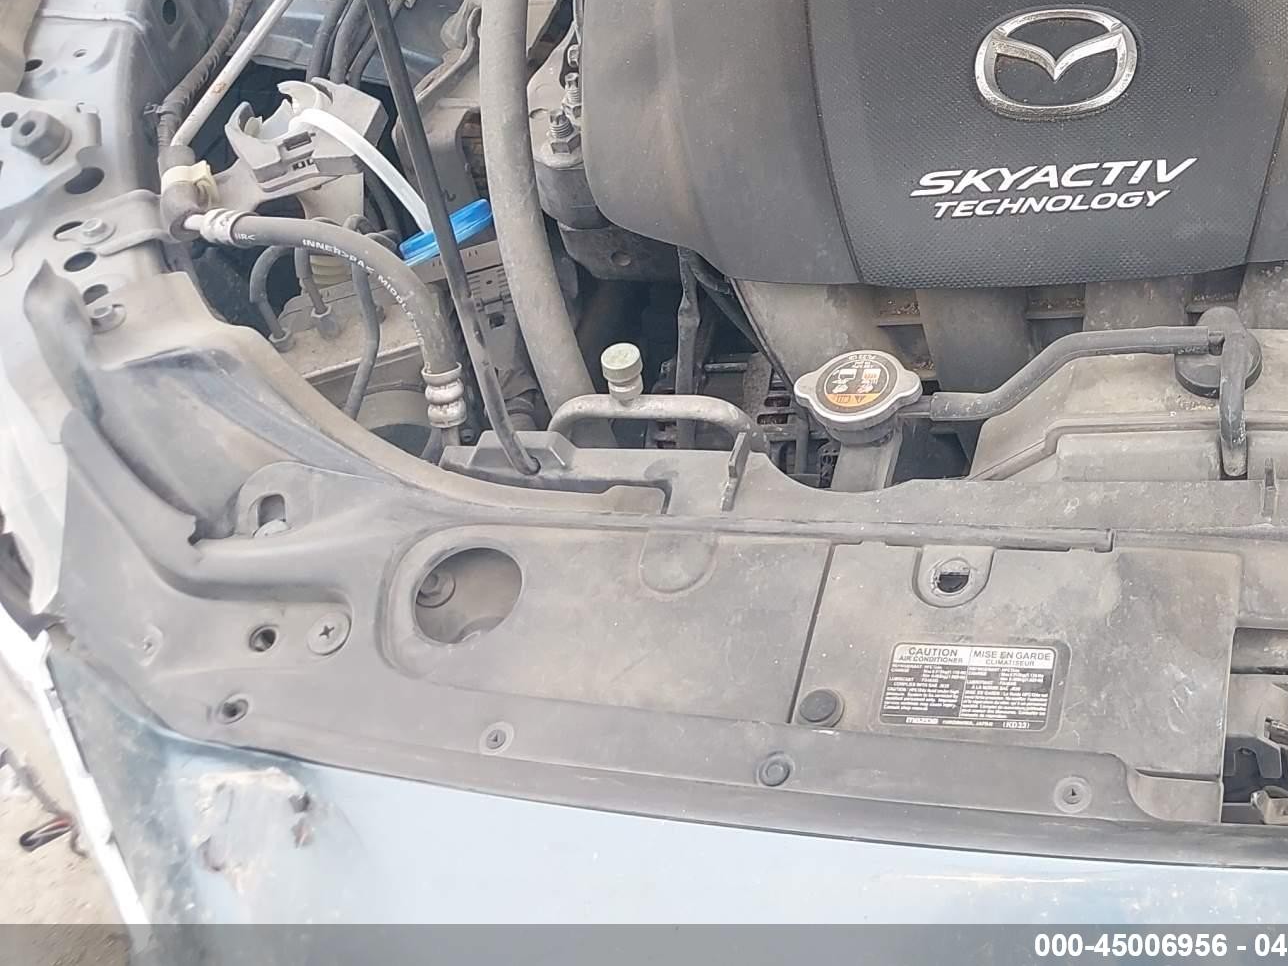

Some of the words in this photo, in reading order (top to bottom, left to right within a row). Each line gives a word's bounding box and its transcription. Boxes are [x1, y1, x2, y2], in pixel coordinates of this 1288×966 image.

[910, 158, 1198, 197] SKYACTIV
[934, 190, 1172, 219] TECHNOLOGY
[908, 646, 958, 657] CAUTION
[973, 649, 998, 659] MISE
[999, 651, 1014, 659] EN
[1015, 651, 1052, 661] GARDE
[912, 656, 963, 664] CONDITIONER
[985, 659, 1035, 667] CLIMATISEUR
